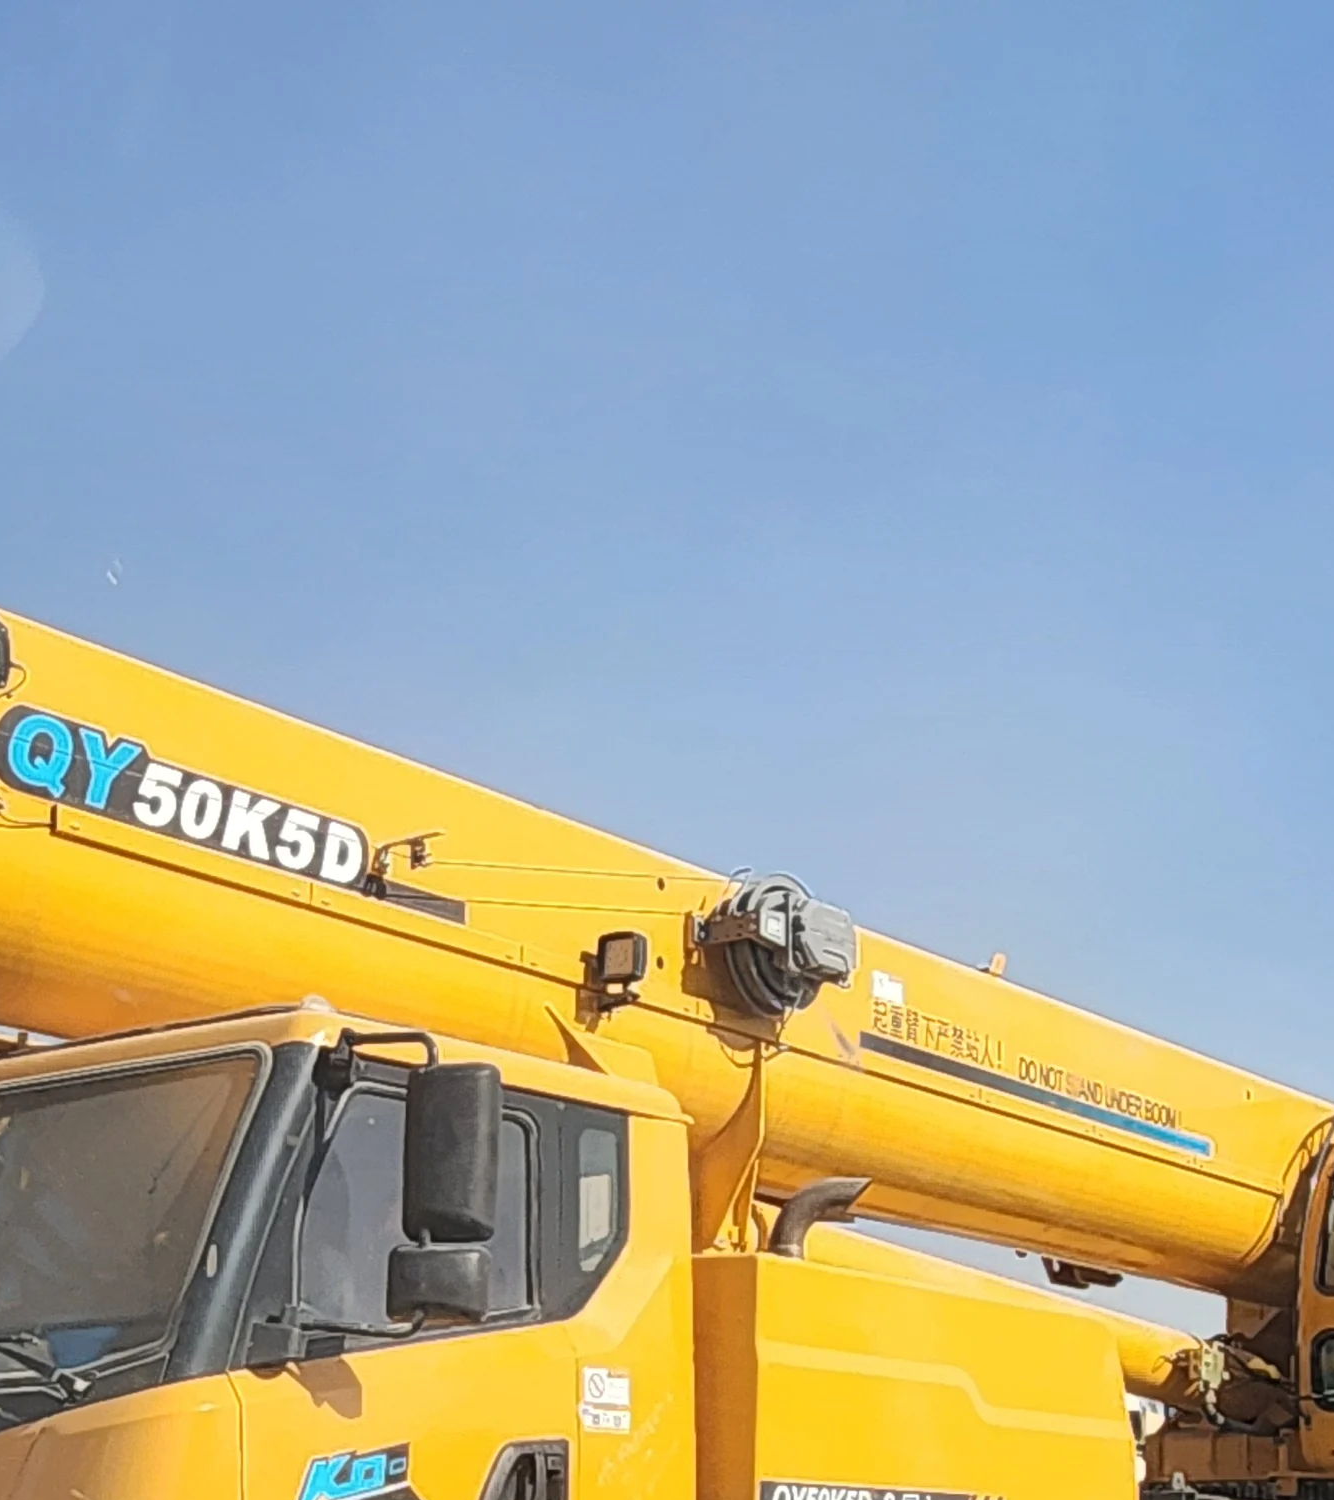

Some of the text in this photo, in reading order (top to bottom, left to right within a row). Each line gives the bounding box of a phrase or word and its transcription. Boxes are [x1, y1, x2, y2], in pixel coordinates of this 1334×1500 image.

[7, 713, 365, 885] QY50K5D
[1018, 1056, 1038, 1083] DO
[1039, 1063, 1064, 1091] NOT
